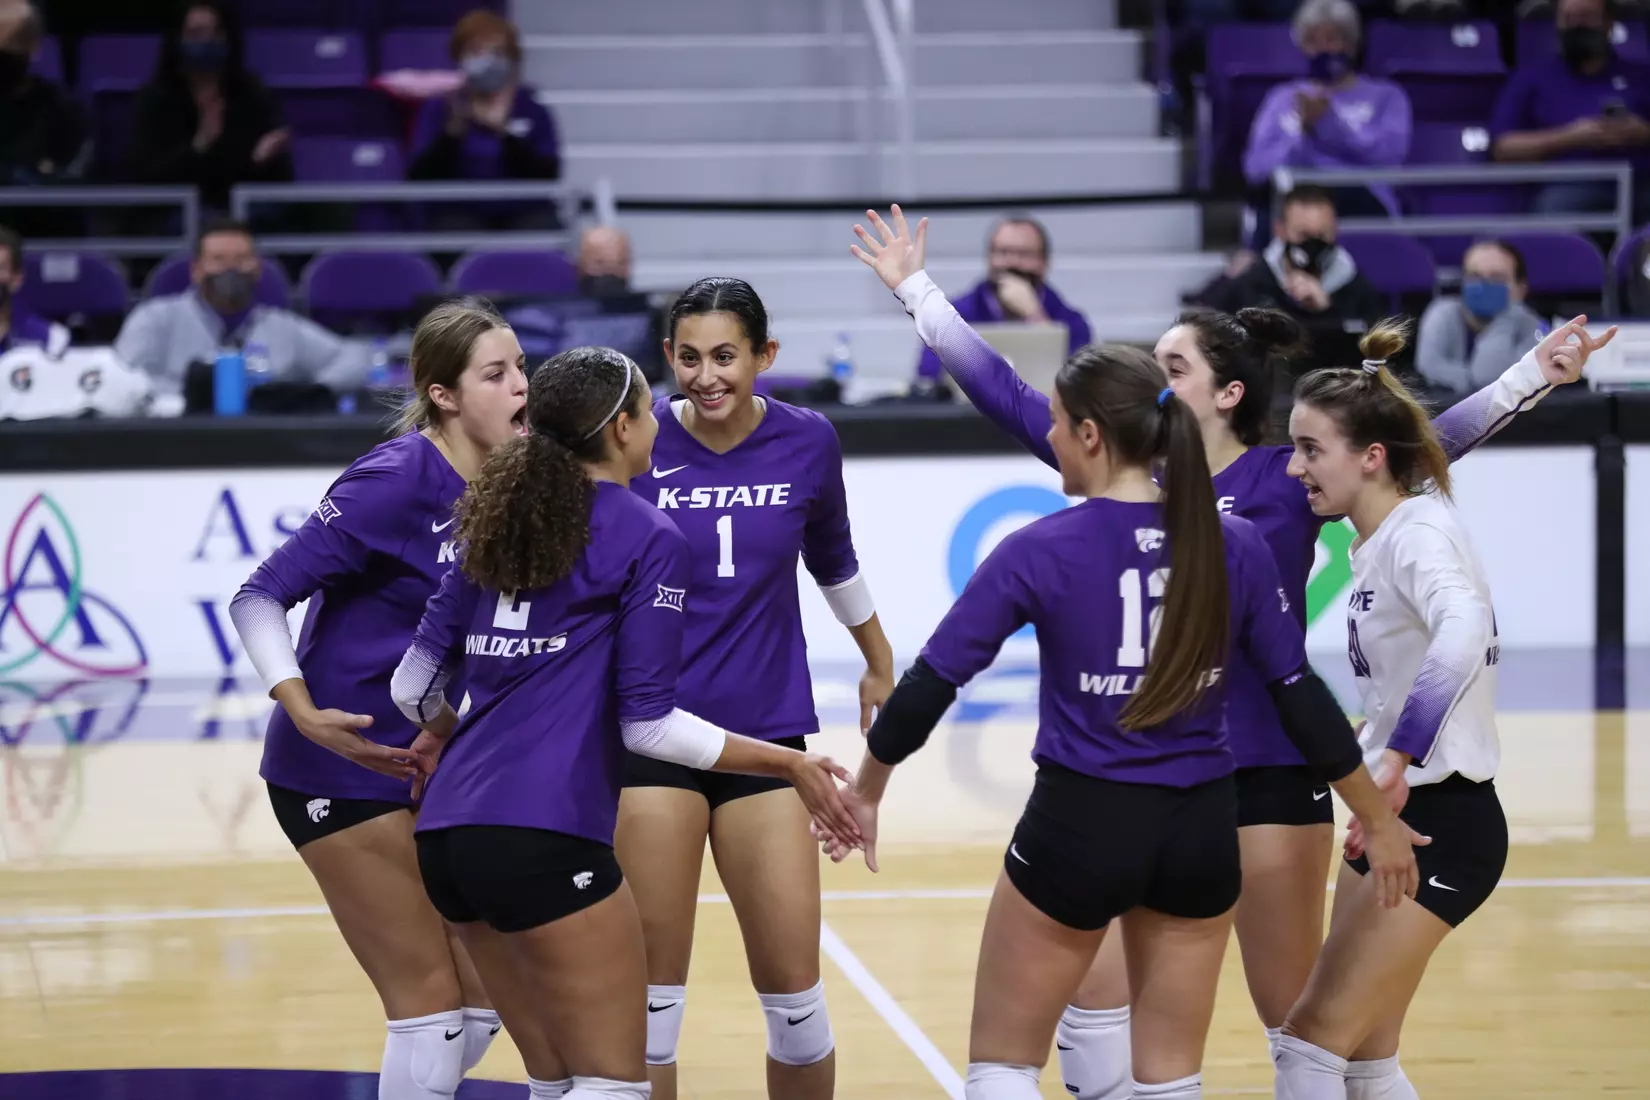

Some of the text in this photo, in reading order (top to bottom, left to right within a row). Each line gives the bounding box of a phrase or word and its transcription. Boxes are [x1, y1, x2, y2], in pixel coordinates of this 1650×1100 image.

[657, 483, 791, 509] K-STATE
[716, 515, 735, 578] 1
[465, 632, 568, 658] WILDCATS
